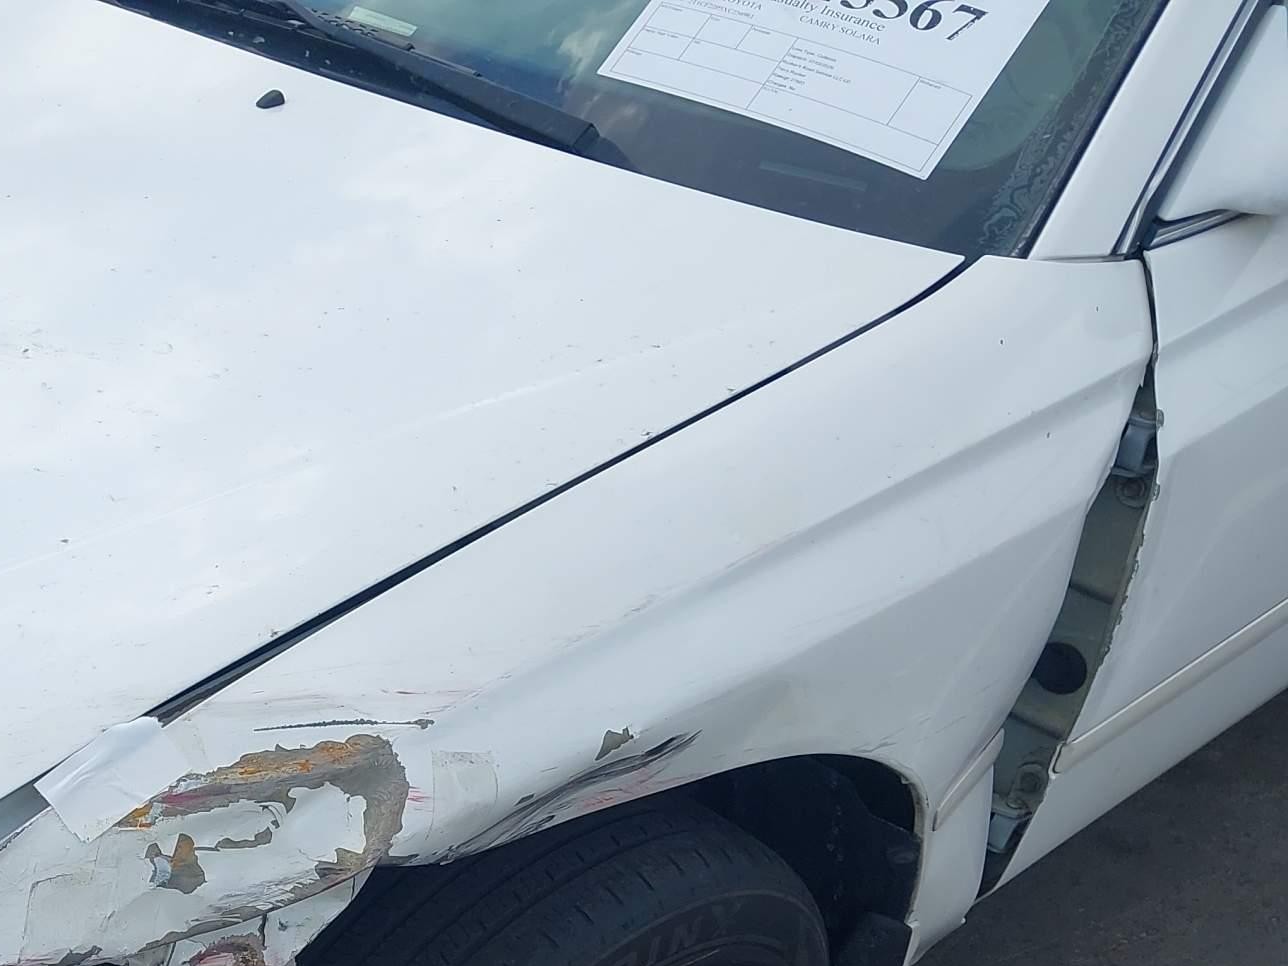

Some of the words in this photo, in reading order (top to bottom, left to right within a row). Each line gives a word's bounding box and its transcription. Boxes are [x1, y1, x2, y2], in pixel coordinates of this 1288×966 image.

[799, 15, 837, 31] CAMRY
[838, 26, 881, 46] SOLARA
[820, 5, 886, 32] Insurance
